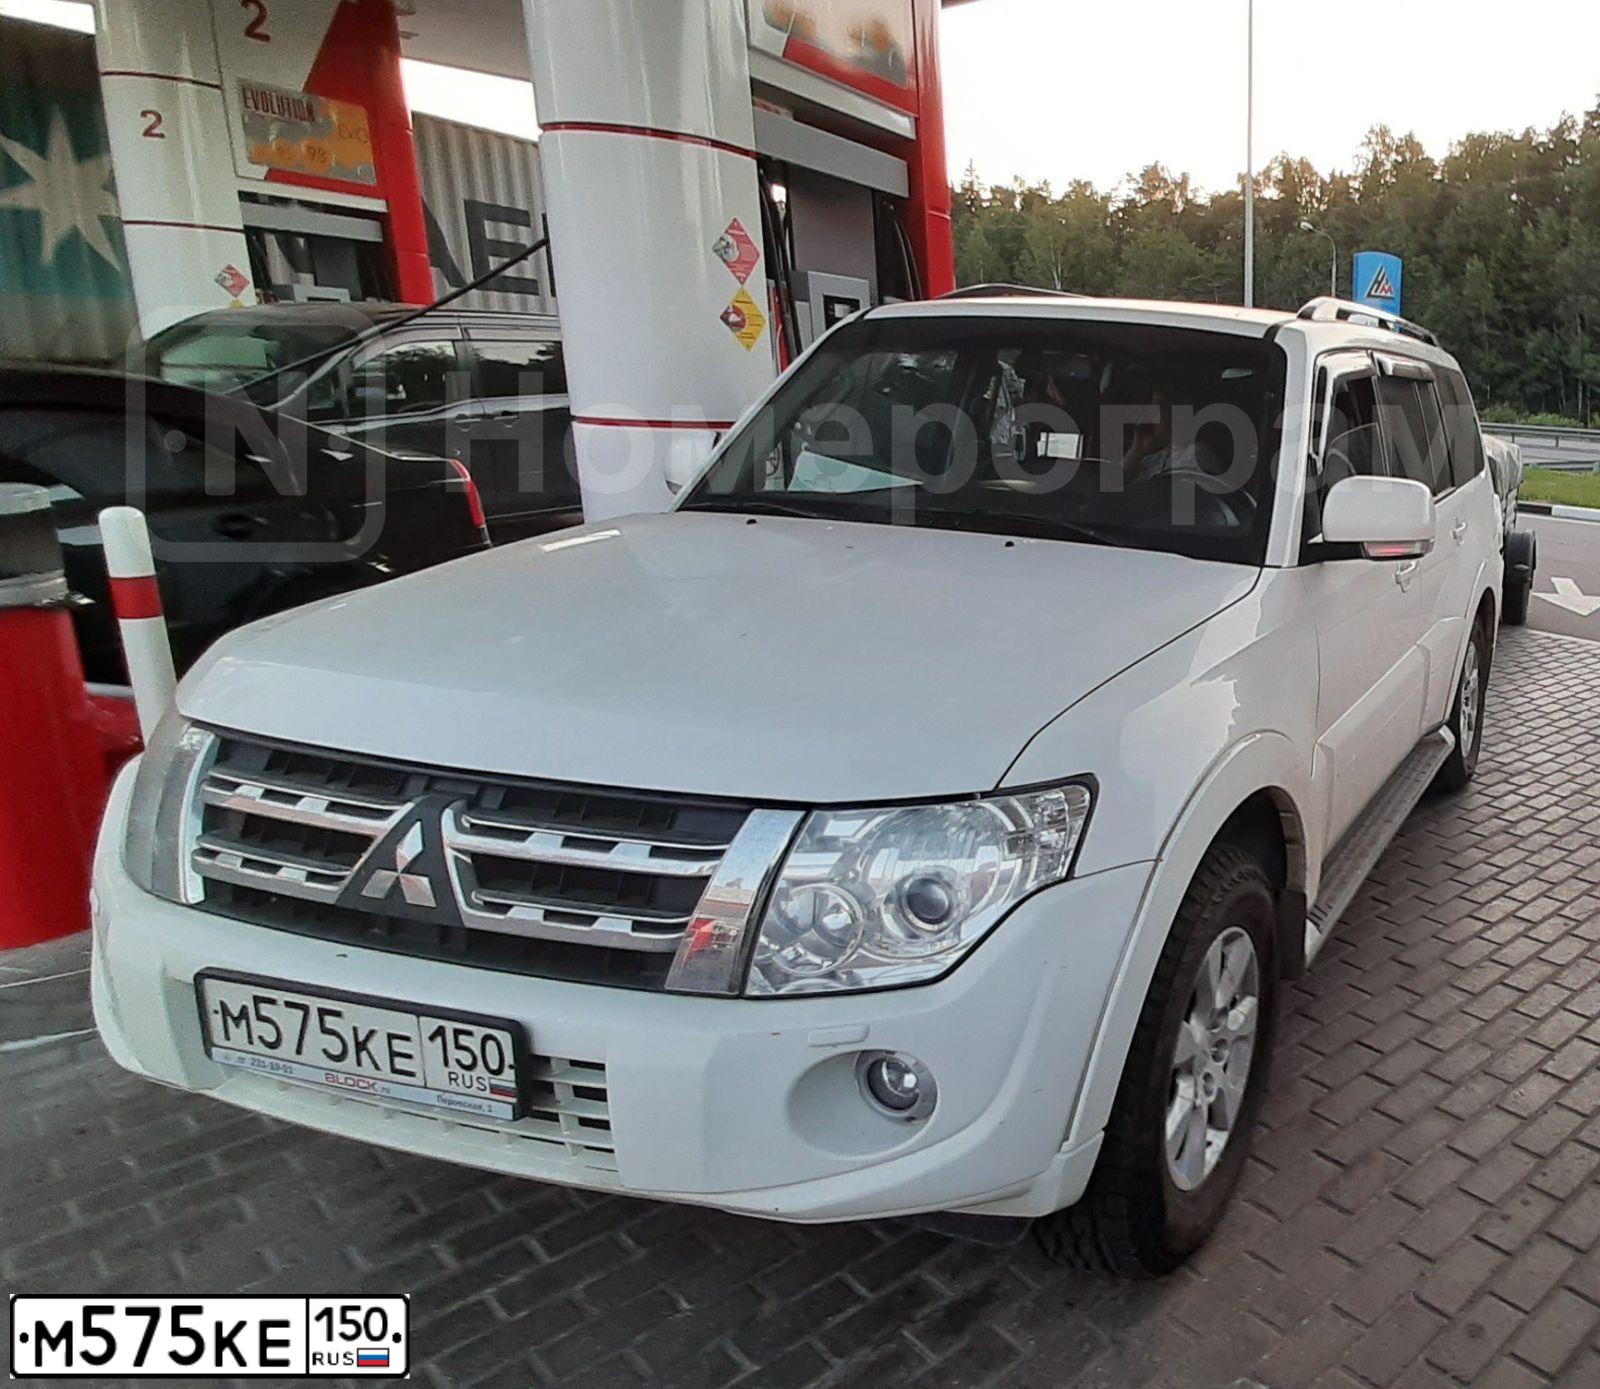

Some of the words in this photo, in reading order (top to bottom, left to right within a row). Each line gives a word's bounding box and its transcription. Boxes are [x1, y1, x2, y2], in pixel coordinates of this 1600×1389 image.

[240, 0, 271, 43] 2
[140, 110, 165, 138] 2
[219, 995, 418, 1079] M575KE
[428, 1024, 505, 1076] 150
[448, 1071, 488, 1092] RUS
